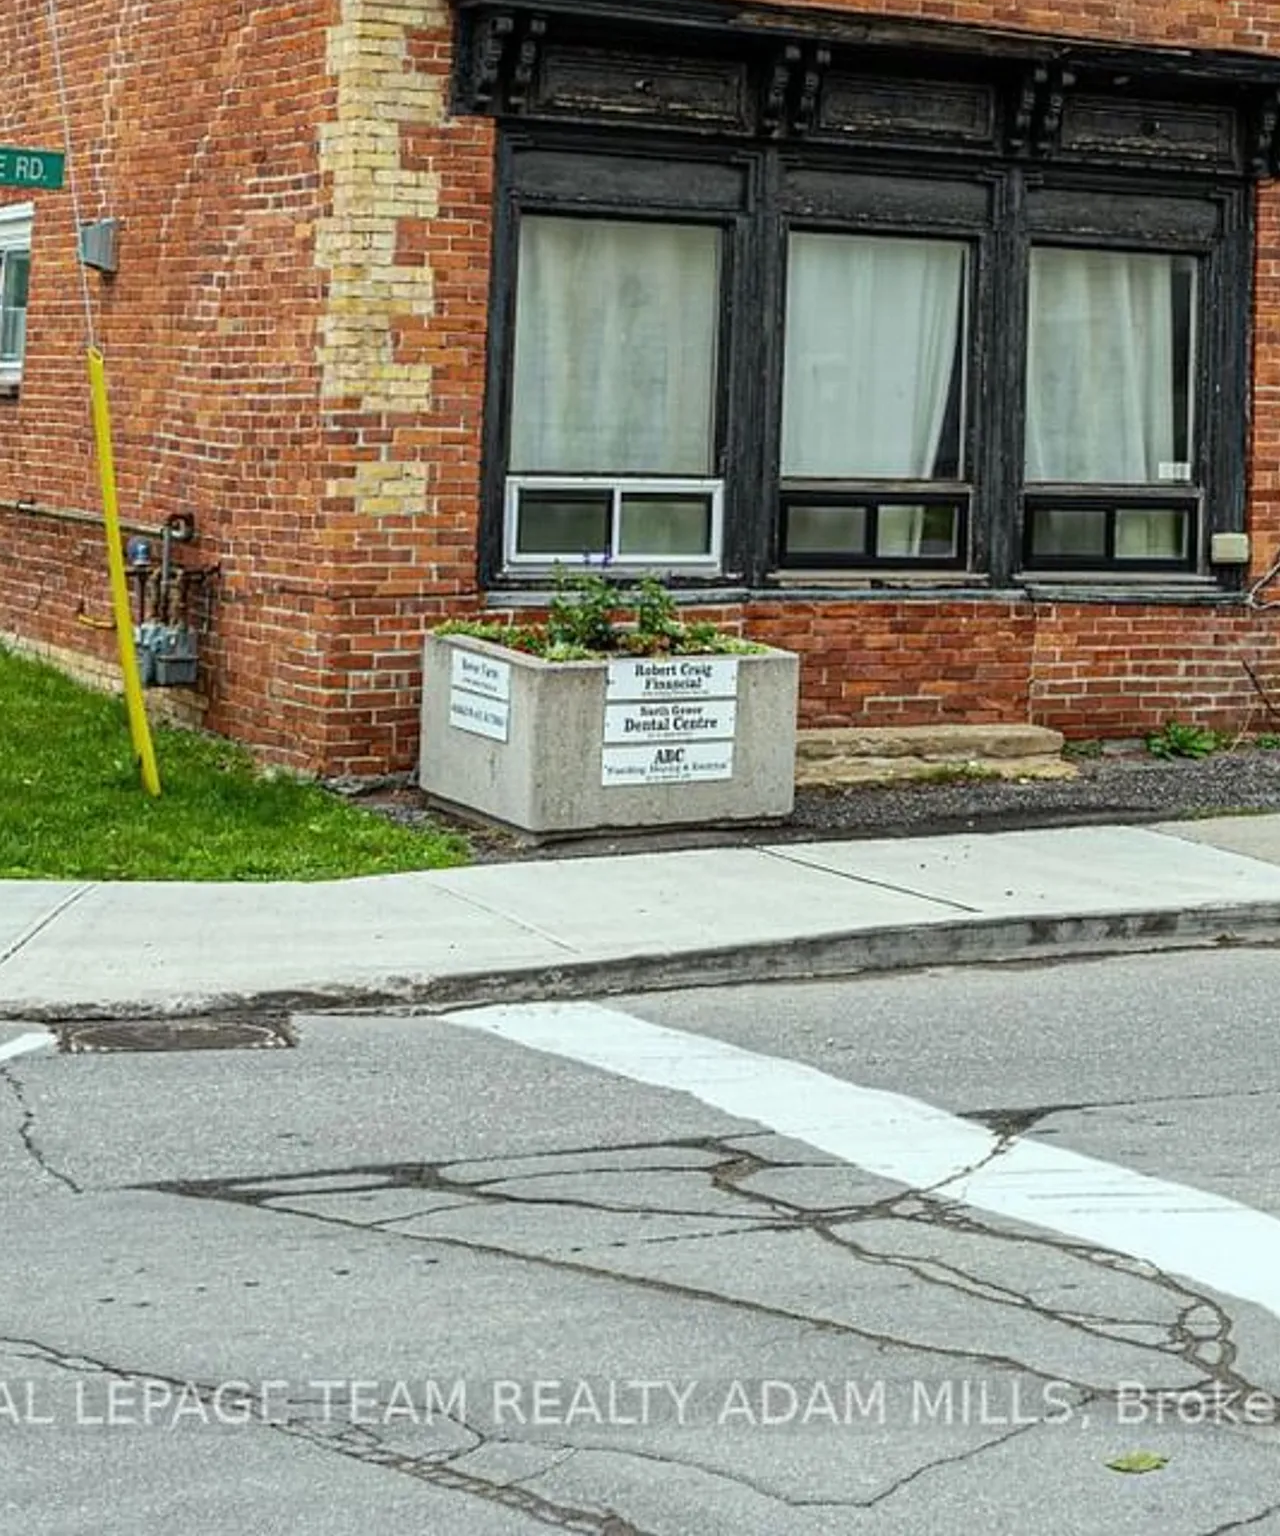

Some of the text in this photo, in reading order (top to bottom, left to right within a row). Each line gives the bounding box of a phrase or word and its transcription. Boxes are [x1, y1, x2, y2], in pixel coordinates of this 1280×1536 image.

[16, 156, 47, 181] RD.
[635, 663, 713, 678] Robert Craig
[645, 677, 702, 690] Financial
[624, 716, 718, 732] Dental Centre
